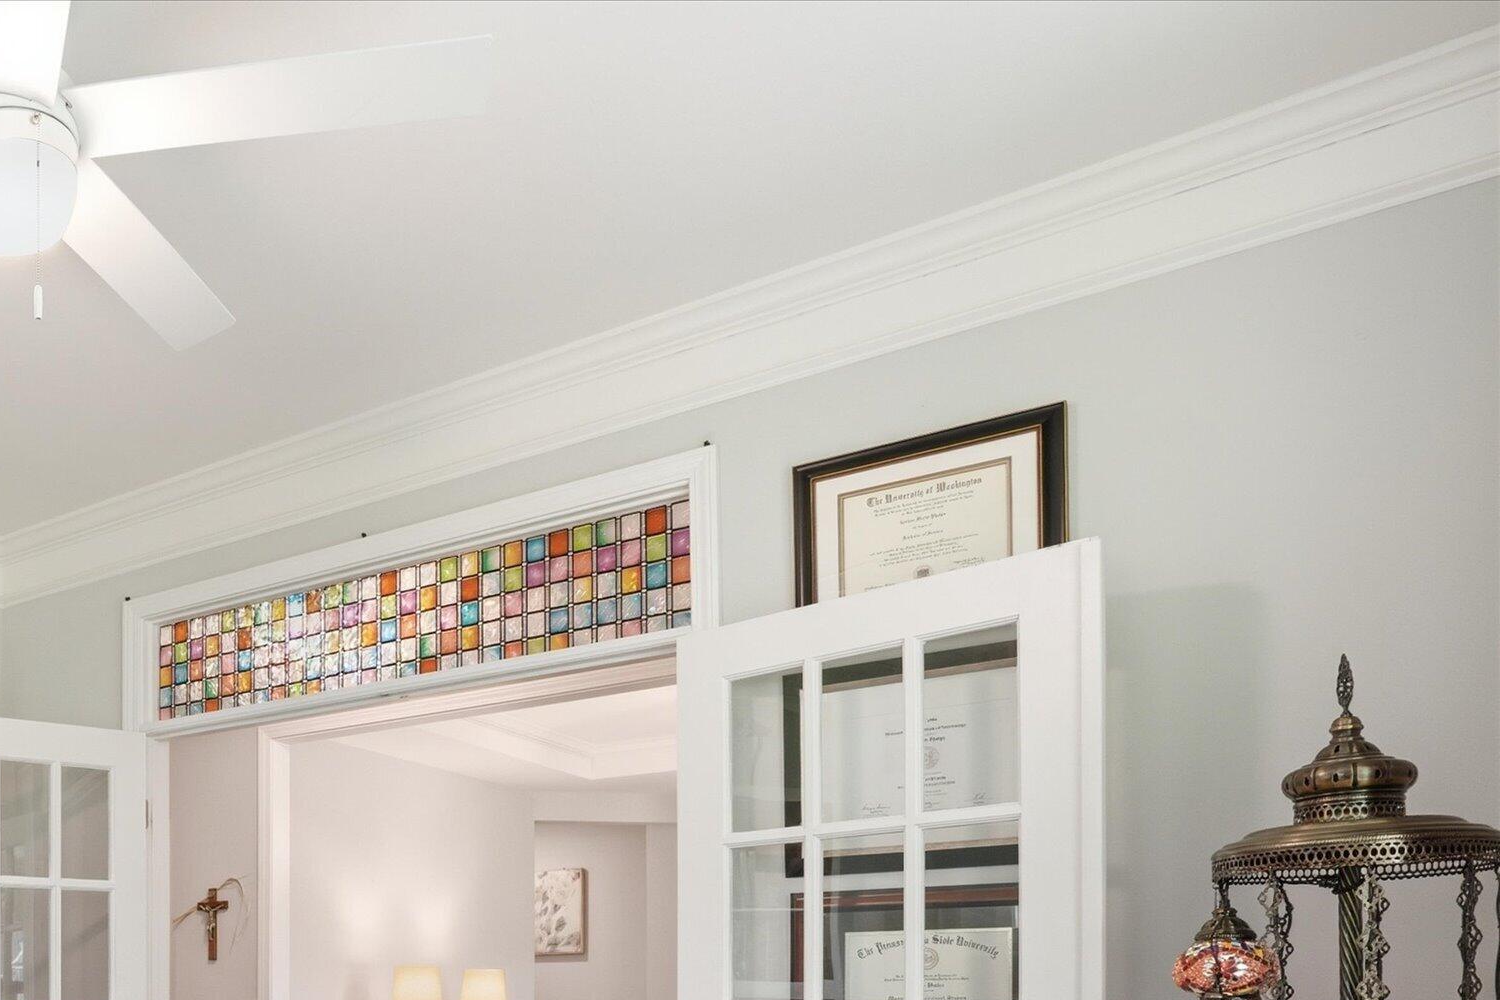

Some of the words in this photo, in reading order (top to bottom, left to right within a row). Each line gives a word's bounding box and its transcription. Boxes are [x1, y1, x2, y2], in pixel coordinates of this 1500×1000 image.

[866, 496, 883, 508] The
[885, 489, 924, 504] University
[925, 486, 934, 495] of
[936, 477, 982, 493] Washington
